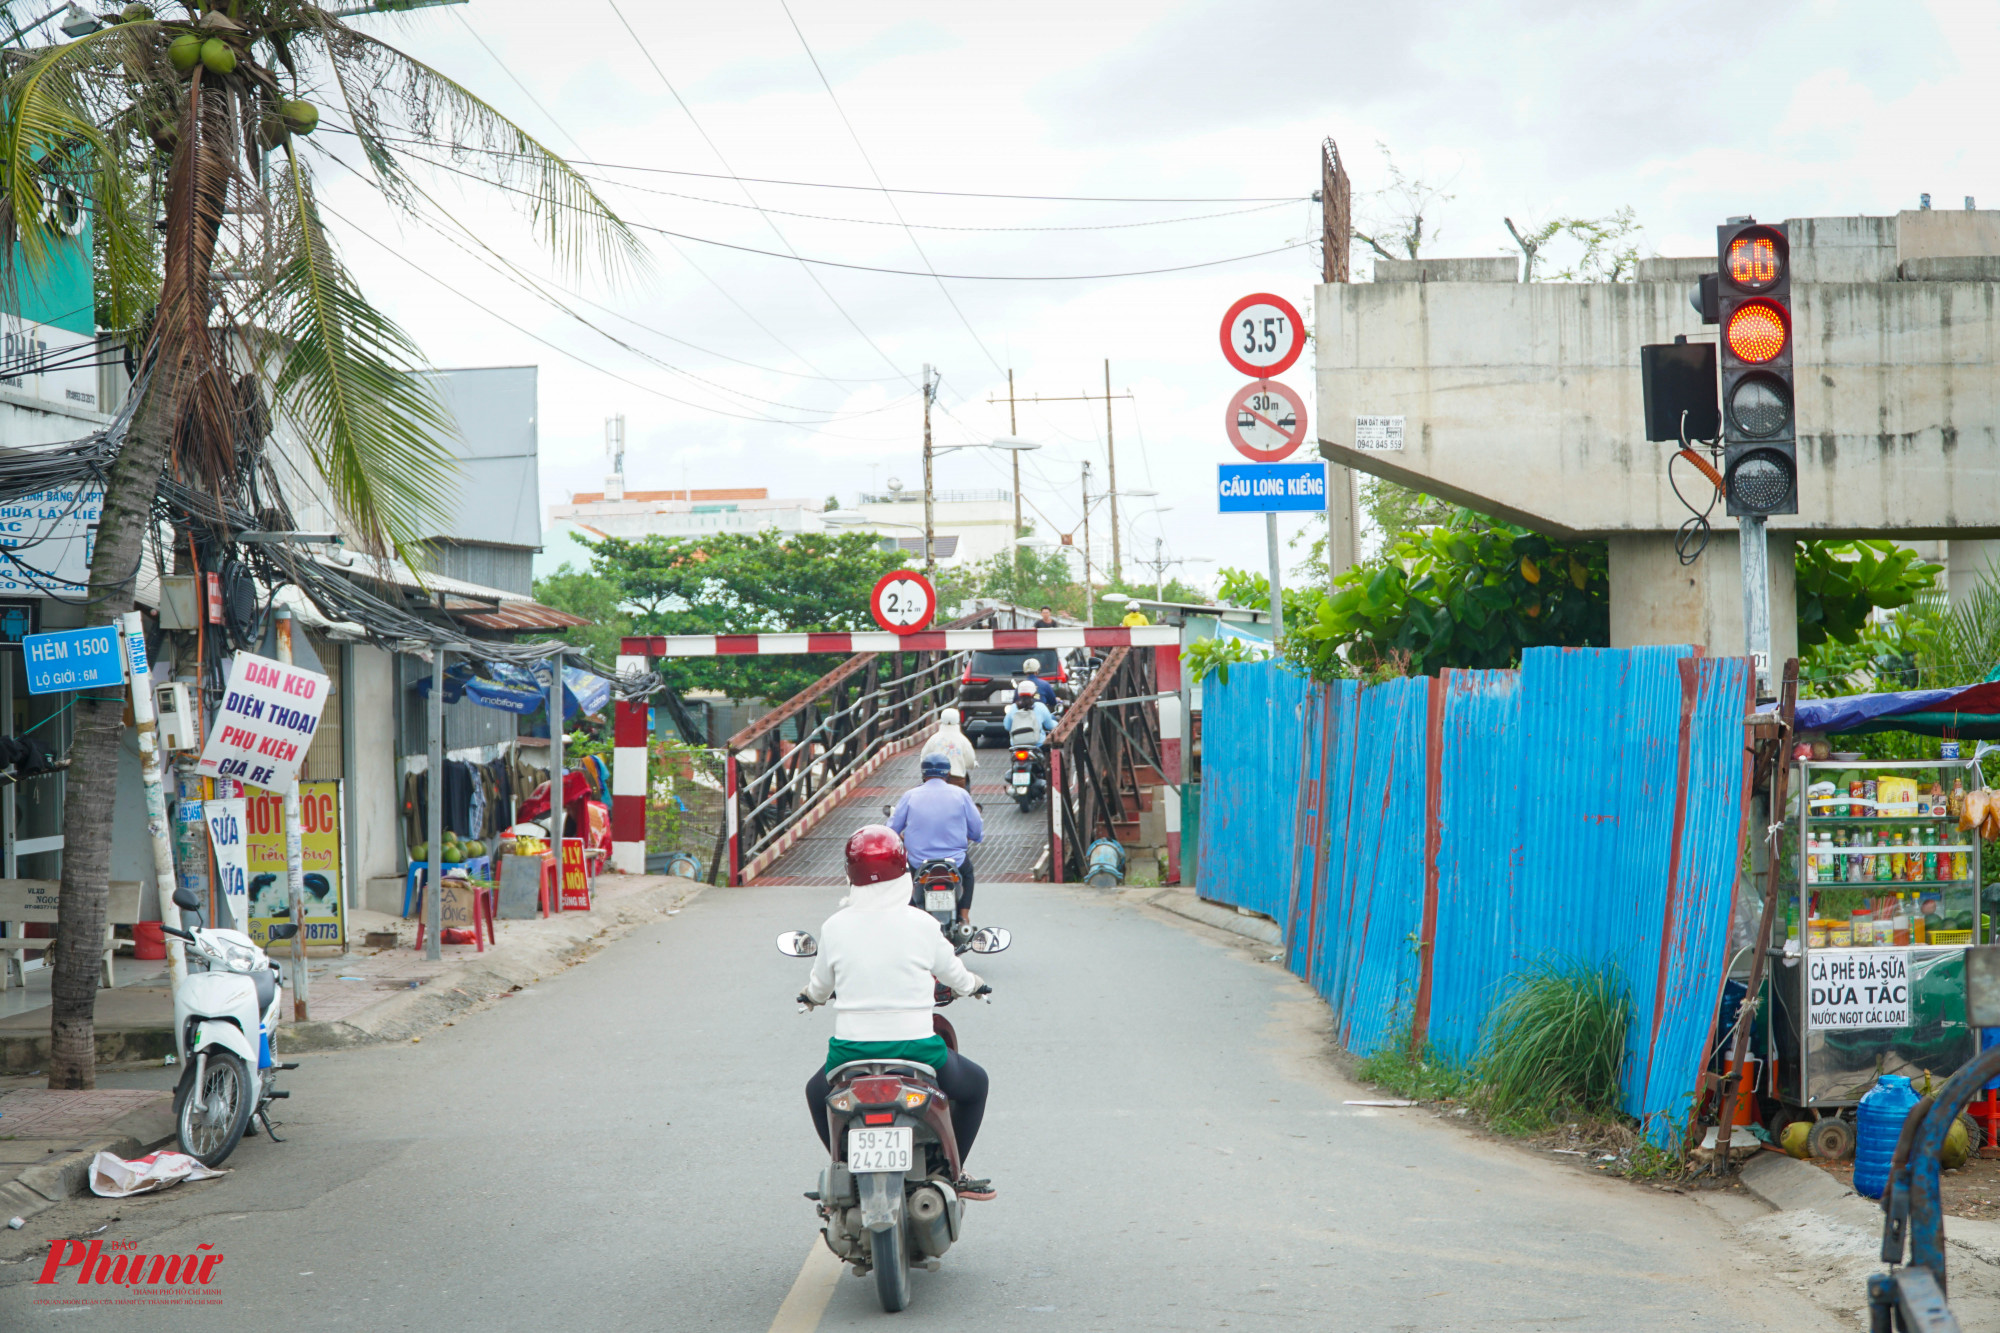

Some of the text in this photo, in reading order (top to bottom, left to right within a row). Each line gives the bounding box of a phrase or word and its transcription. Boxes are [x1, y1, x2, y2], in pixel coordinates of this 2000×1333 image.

[1732, 239, 1774, 281] 60
[1253, 479, 1284, 496] LONG
[1288, 472, 1323, 496] KIỂNG
[31, 639, 69, 662] HẺM
[74, 637, 109, 656] 1500
[36, 672, 51, 688] LỘ
[53, 668, 76, 684] GIỚI
[84, 669, 98, 681] 6M
[245, 662, 316, 699] DÁN KEO
[225, 691, 317, 736] ĐIỆN THOẠI
[480, 696, 524, 709] mobifone
[220, 725, 298, 762] PHỤ KIỆN
[218, 758, 248, 777] GIÁ
[249, 765, 275, 784] RẺ
[299, 788, 333, 834] ÓC
[303, 847, 332, 869] ông
[566, 867, 585, 889] MỚI
[1811, 955, 1906, 981] CÀ PHÊ ĐÁ-SỮA
[1811, 980, 1906, 1006] DỪA TẮC
[1812, 1007, 1905, 1027] NƯỚC NGỌT CÁC LOẠI
[859, 1131, 900, 1149] 59-Z1
[853, 1150, 907, 1169] 242.09
